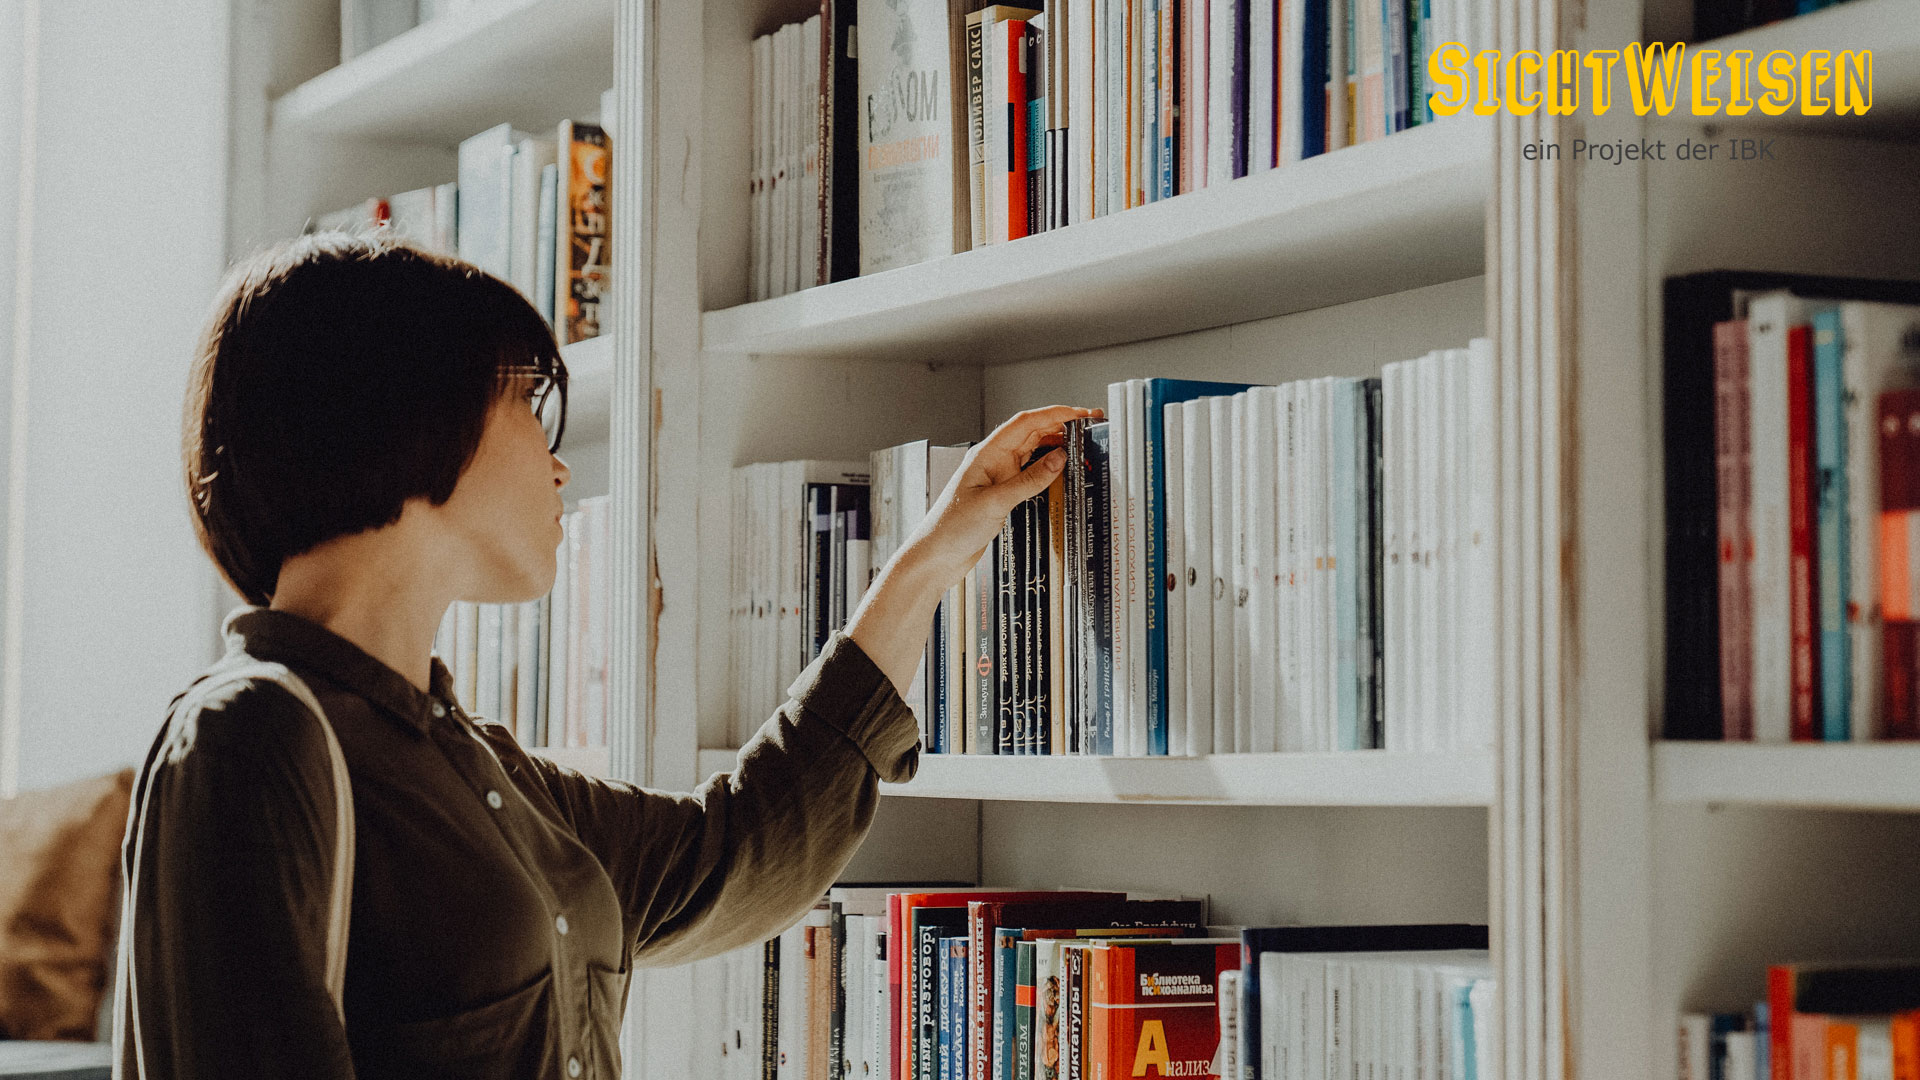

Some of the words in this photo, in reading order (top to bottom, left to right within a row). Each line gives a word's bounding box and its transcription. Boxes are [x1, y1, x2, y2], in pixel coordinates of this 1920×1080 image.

[971, 30, 981, 69] САКС
[972, 76, 983, 138] ОЛИВЕР
[1101, 459, 1109, 535] ПСИХОАНАЛИЗА
[1112, 430, 1120, 530] ПСИХОЛОГИЯ
[1146, 440, 1155, 563] ПСИХОТЕРАПИИ
[1087, 523, 1095, 561] Театры
[1128, 497, 1136, 603] ПСИХОЛОГИЯ
[1113, 533, 1122, 670] ИНДИВИДУАЛЬНАЯ
[1148, 566, 1156, 630] ИСТОКИ
[976, 637, 992, 677] Фрейд
[980, 679, 989, 719] Зигмунд
[1104, 699, 1110, 710] Р.
[921, 931, 935, 1026] разговор
[940, 947, 950, 1033] ДИСКУРС
[975, 917, 988, 1007] практики
[1140, 973, 1201, 987] Библиотека
[1142, 984, 1214, 996] психоанализа
[976, 1010, 985, 1023] и
[1071, 987, 1082, 1080] иктатуры
[976, 1027, 988, 1080] еории
[1019, 1025, 1028, 1080] ТИЗМ
[1131, 1020, 1212, 1078] Анализ
